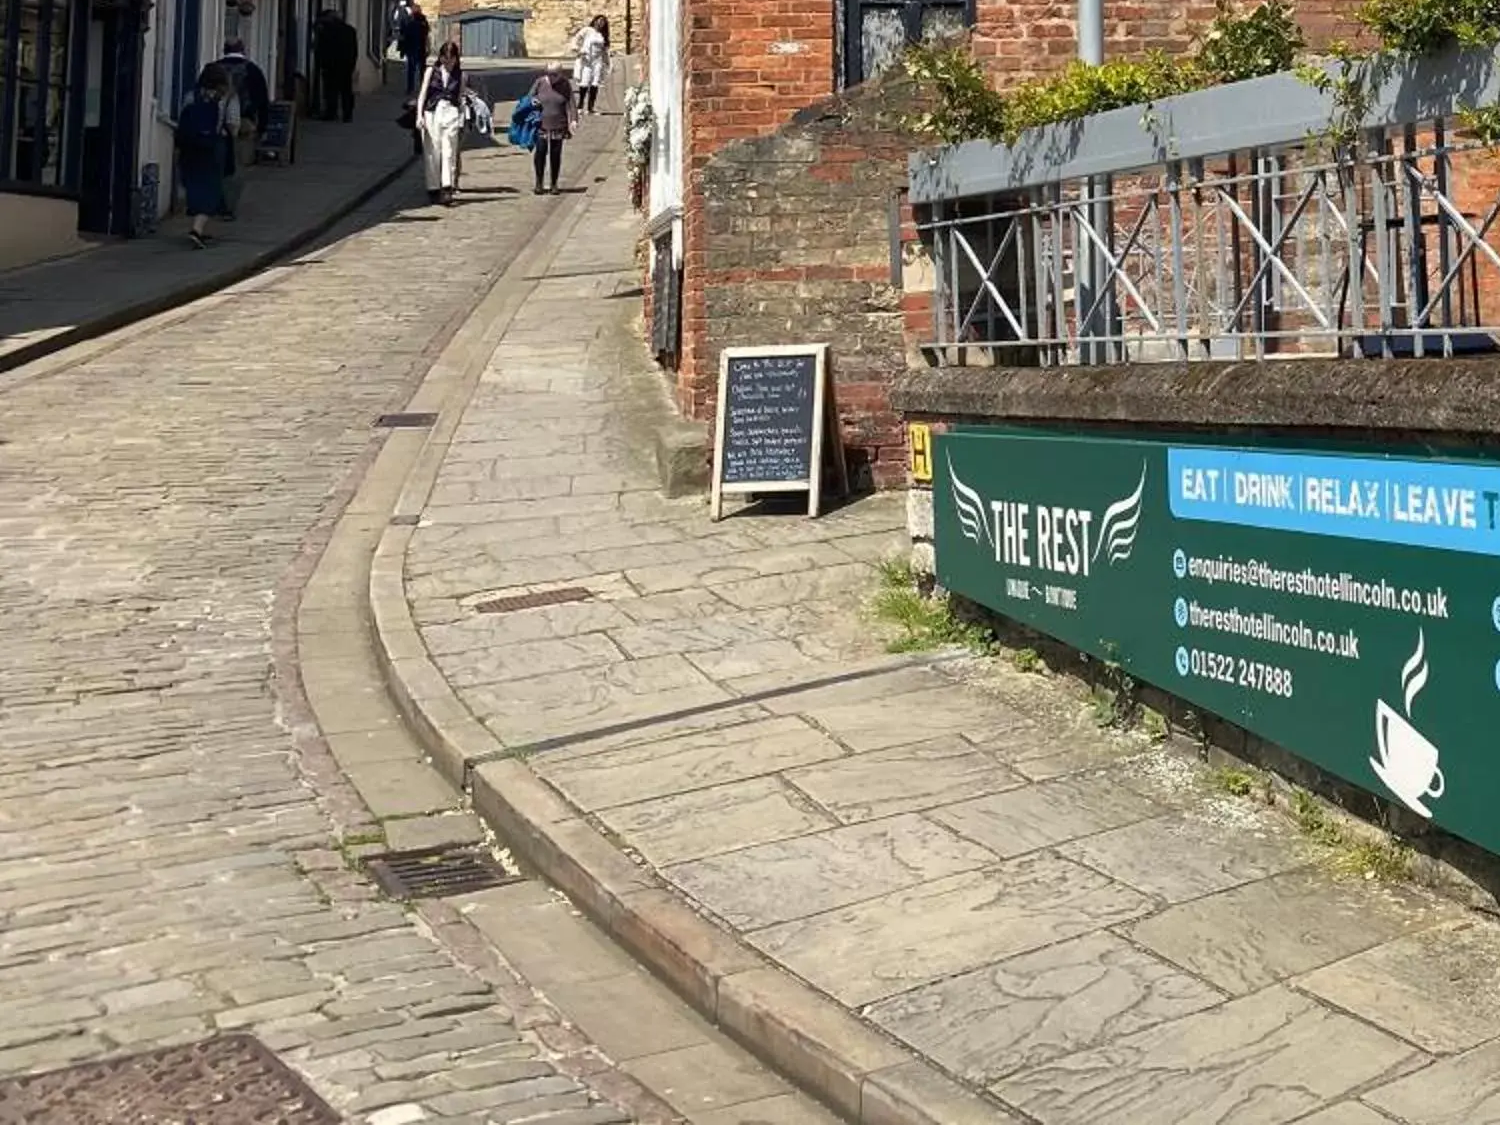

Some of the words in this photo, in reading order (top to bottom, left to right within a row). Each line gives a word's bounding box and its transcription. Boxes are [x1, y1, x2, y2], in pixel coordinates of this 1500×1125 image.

[1182, 468, 1219, 501] EAT
[1235, 472, 1294, 511] DRINK
[1306, 477, 1379, 519] RELAX
[1393, 483, 1477, 529] LEAVE
[990, 500, 1031, 567] THE
[1036, 505, 1093, 577] REST
[1188, 554, 1449, 619] enquiries@theresthotellincoln.co.uk
[1189, 600, 1360, 660] theresthotellincoln.co.uk
[1191, 648, 1235, 683] 01522
[1239, 657, 1293, 698] 247888
